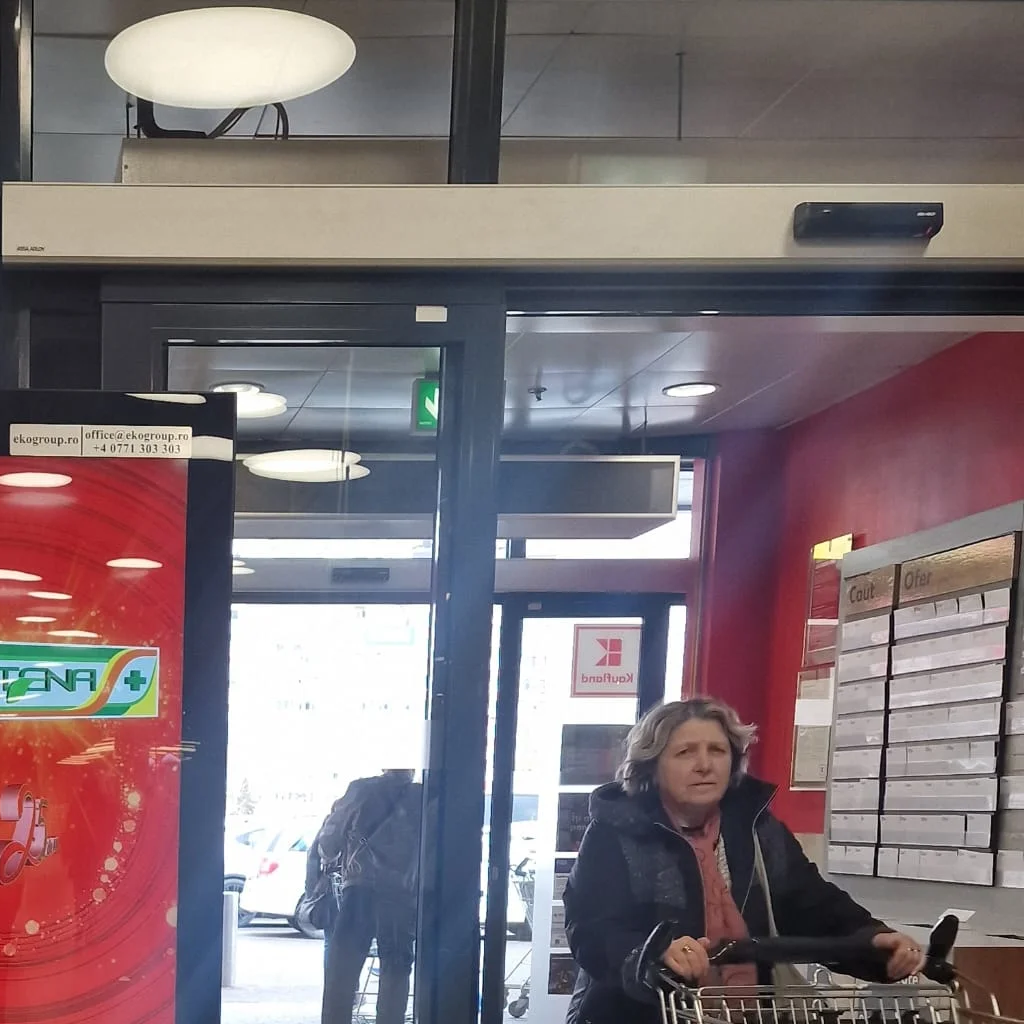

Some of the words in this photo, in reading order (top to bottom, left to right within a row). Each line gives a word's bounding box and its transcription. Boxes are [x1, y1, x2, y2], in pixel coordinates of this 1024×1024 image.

[13, 433, 79, 446] ekogroup.ro
[85, 429, 189, 442] office@ekogroup.ro
[93, 444, 107, 453] +4
[110, 444, 135, 453] 0771
[139, 444, 159, 454] 303
[162, 444, 181, 454] 303
